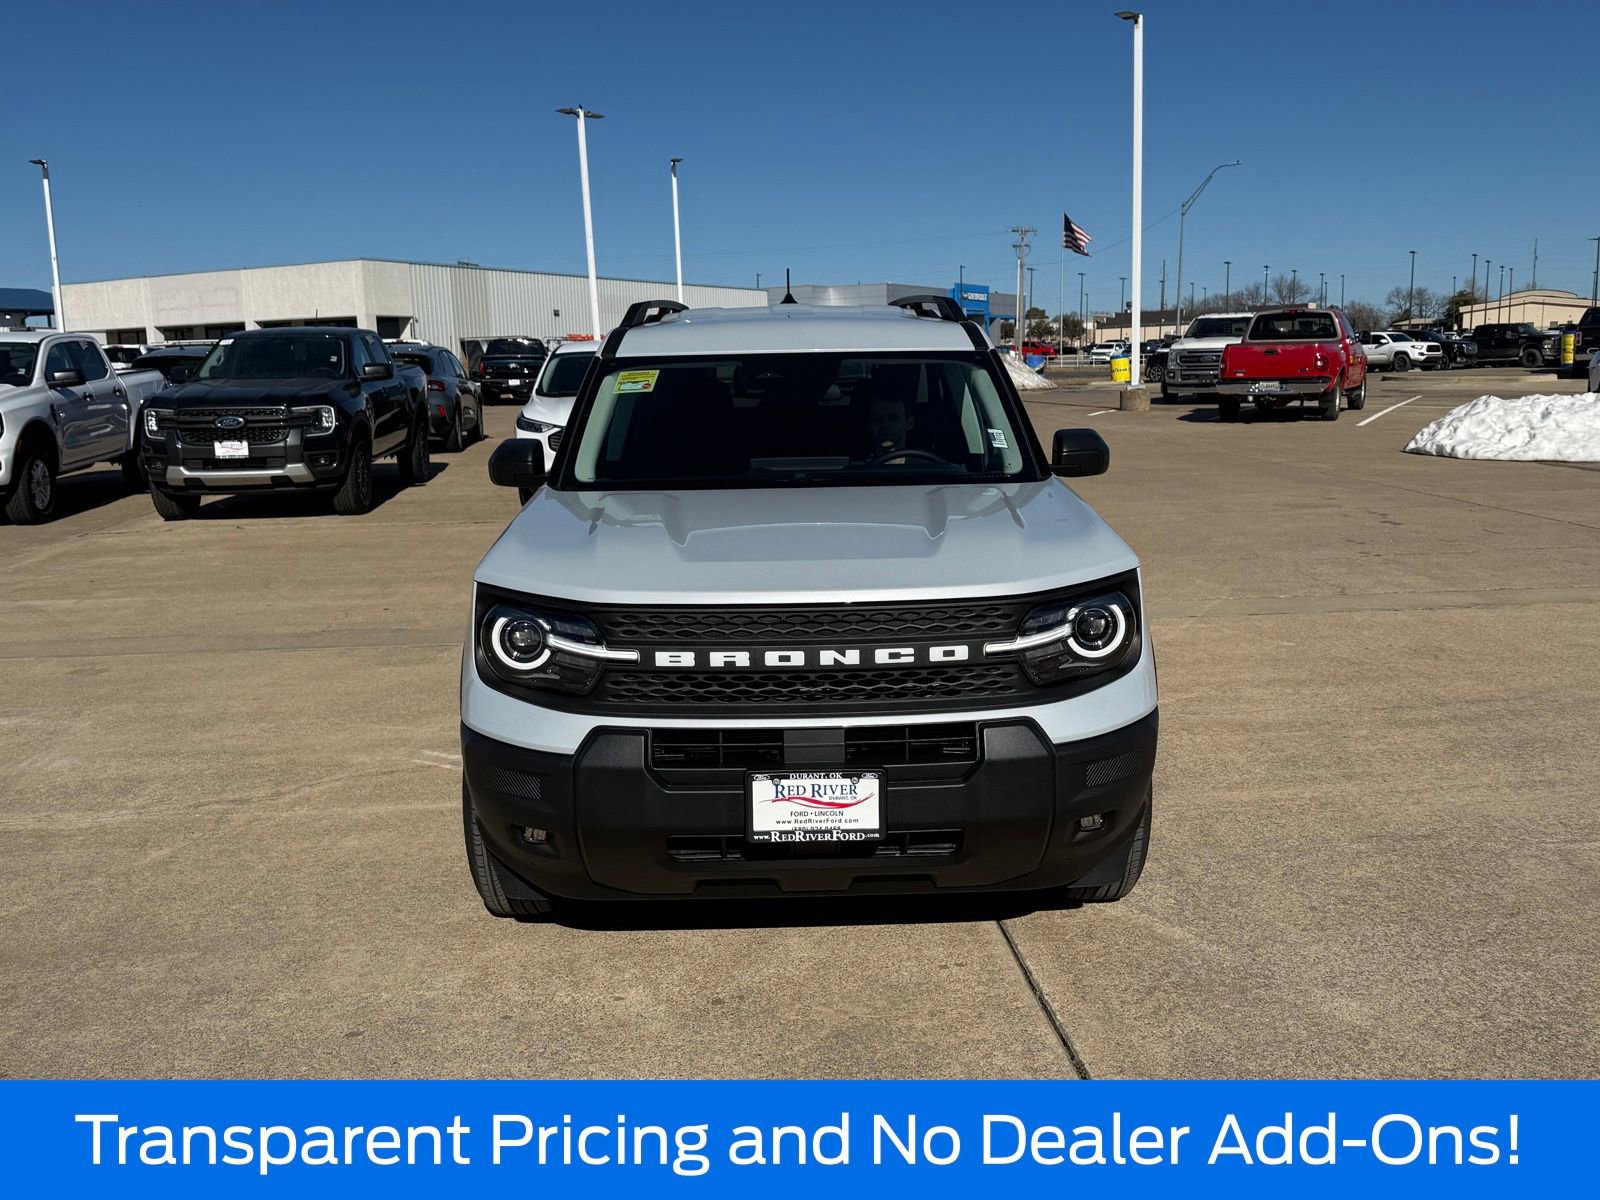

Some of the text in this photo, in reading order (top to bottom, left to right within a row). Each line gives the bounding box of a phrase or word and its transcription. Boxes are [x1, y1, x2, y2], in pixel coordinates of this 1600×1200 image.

[655, 645, 969, 667] BRONCO
[774, 783, 858, 798] RED RIVER
